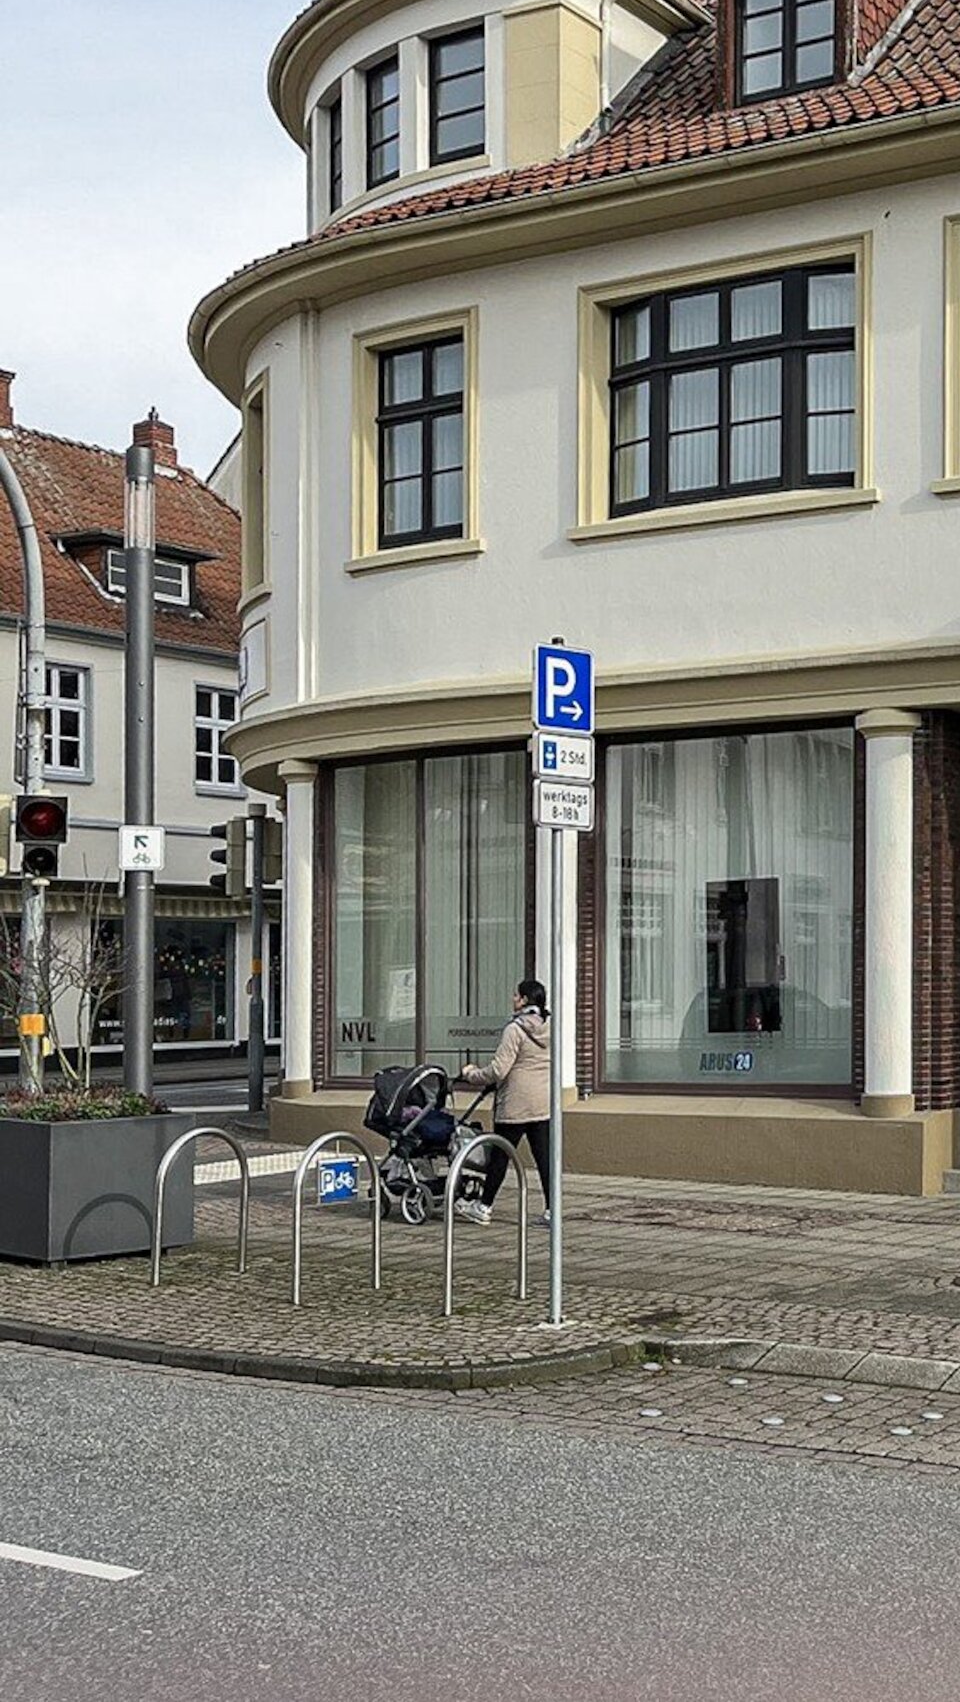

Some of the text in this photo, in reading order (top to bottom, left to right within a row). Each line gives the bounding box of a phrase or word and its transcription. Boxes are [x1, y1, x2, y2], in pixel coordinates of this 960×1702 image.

[546, 656, 577, 719] P
[560, 750, 567, 764] 2
[543, 791, 588, 808] werktags
[342, 1022, 376, 1042] NVL
